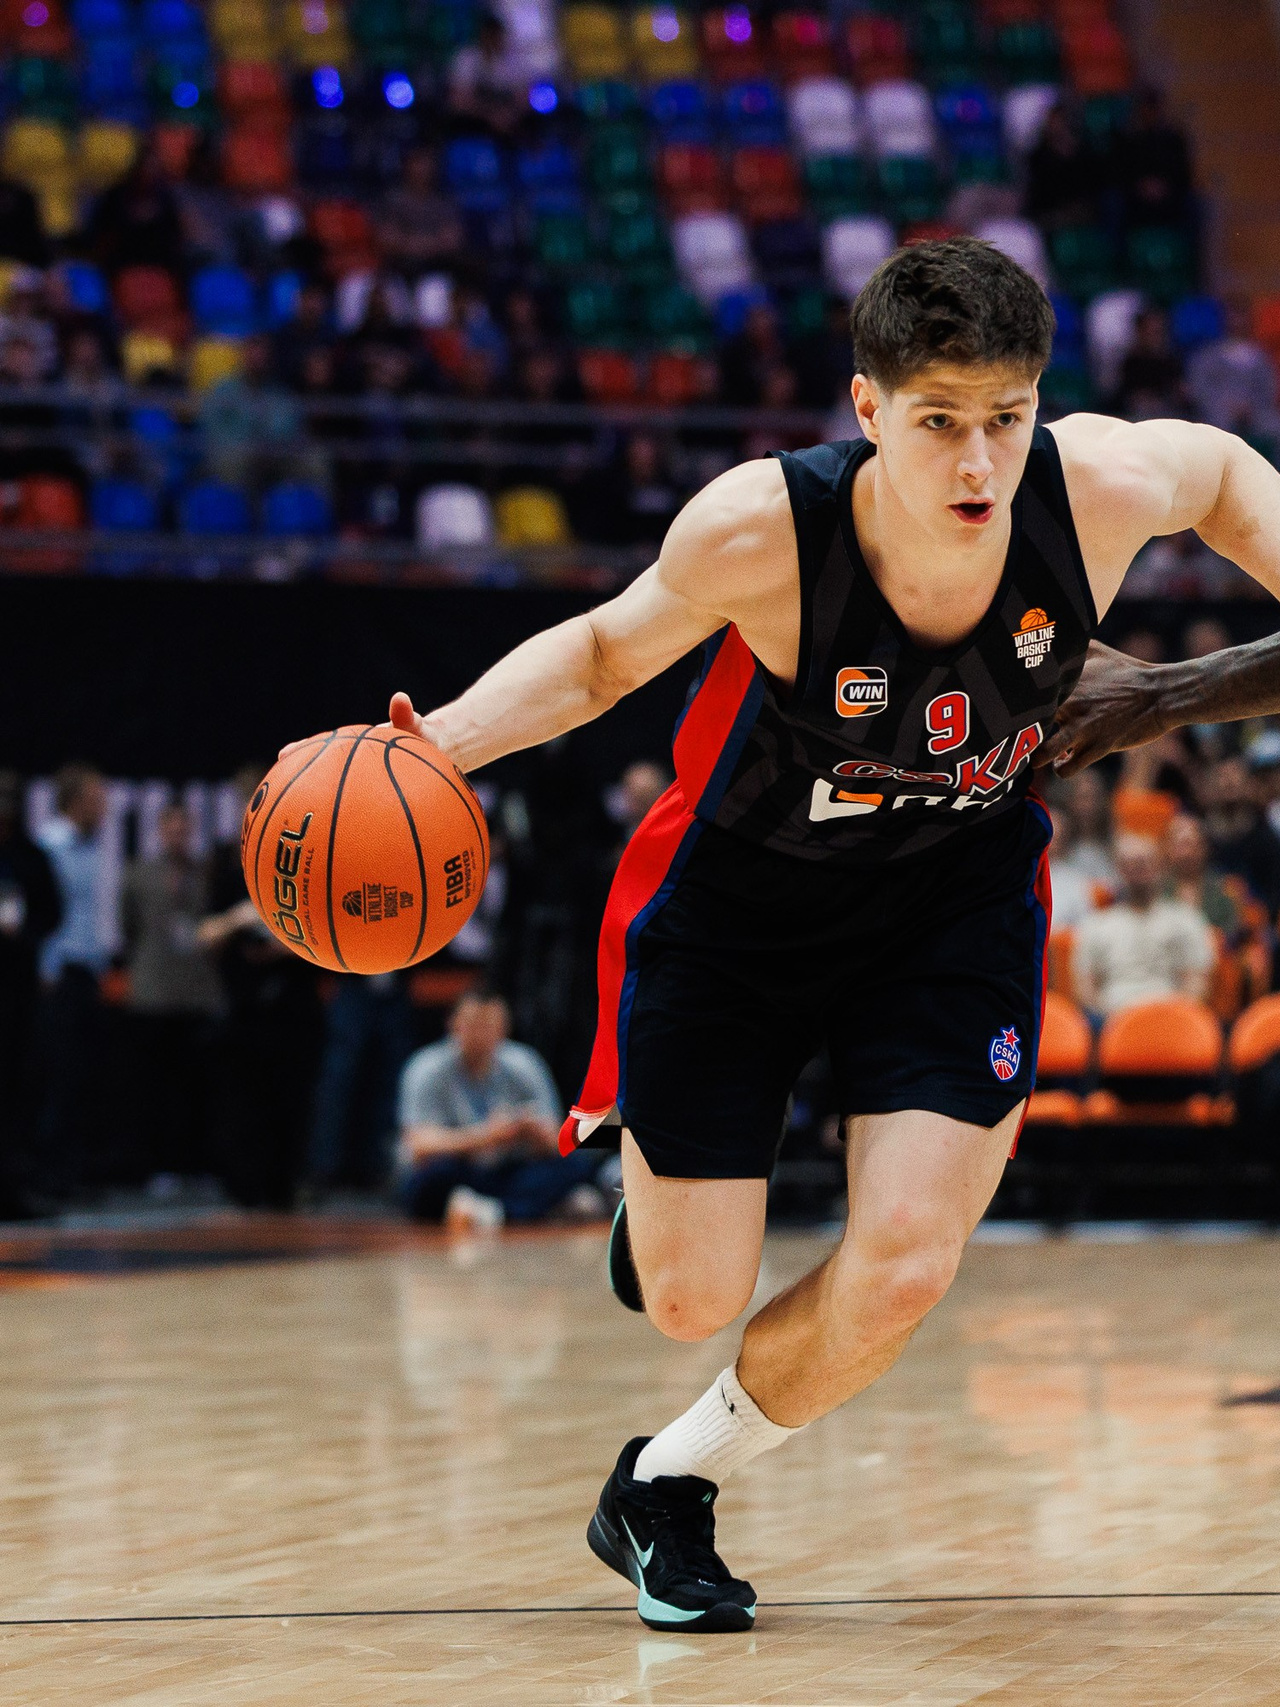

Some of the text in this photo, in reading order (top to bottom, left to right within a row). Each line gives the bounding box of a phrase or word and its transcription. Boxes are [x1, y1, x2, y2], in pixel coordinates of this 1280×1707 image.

[1014, 625, 1055, 647] WINLINE
[1017, 640, 1052, 658] BASKET
[1025, 655, 1044, 669] CUP
[849, 685, 883, 700] WIN
[925, 691, 970, 755] 9
[832, 721, 1044, 797] CSKA
[304, 847, 315, 875] BALL
[462, 850, 471, 899] APPROVED
[272, 811, 320, 961] JÖGEL
[303, 878, 311, 907] GAME
[443, 855, 464, 909] FIBA
[367, 882, 382, 922] WINLINE
[383, 885, 398, 918] BASKET
[399, 890, 414, 909] CUP
[995, 1044, 1017, 1065] CSKA
